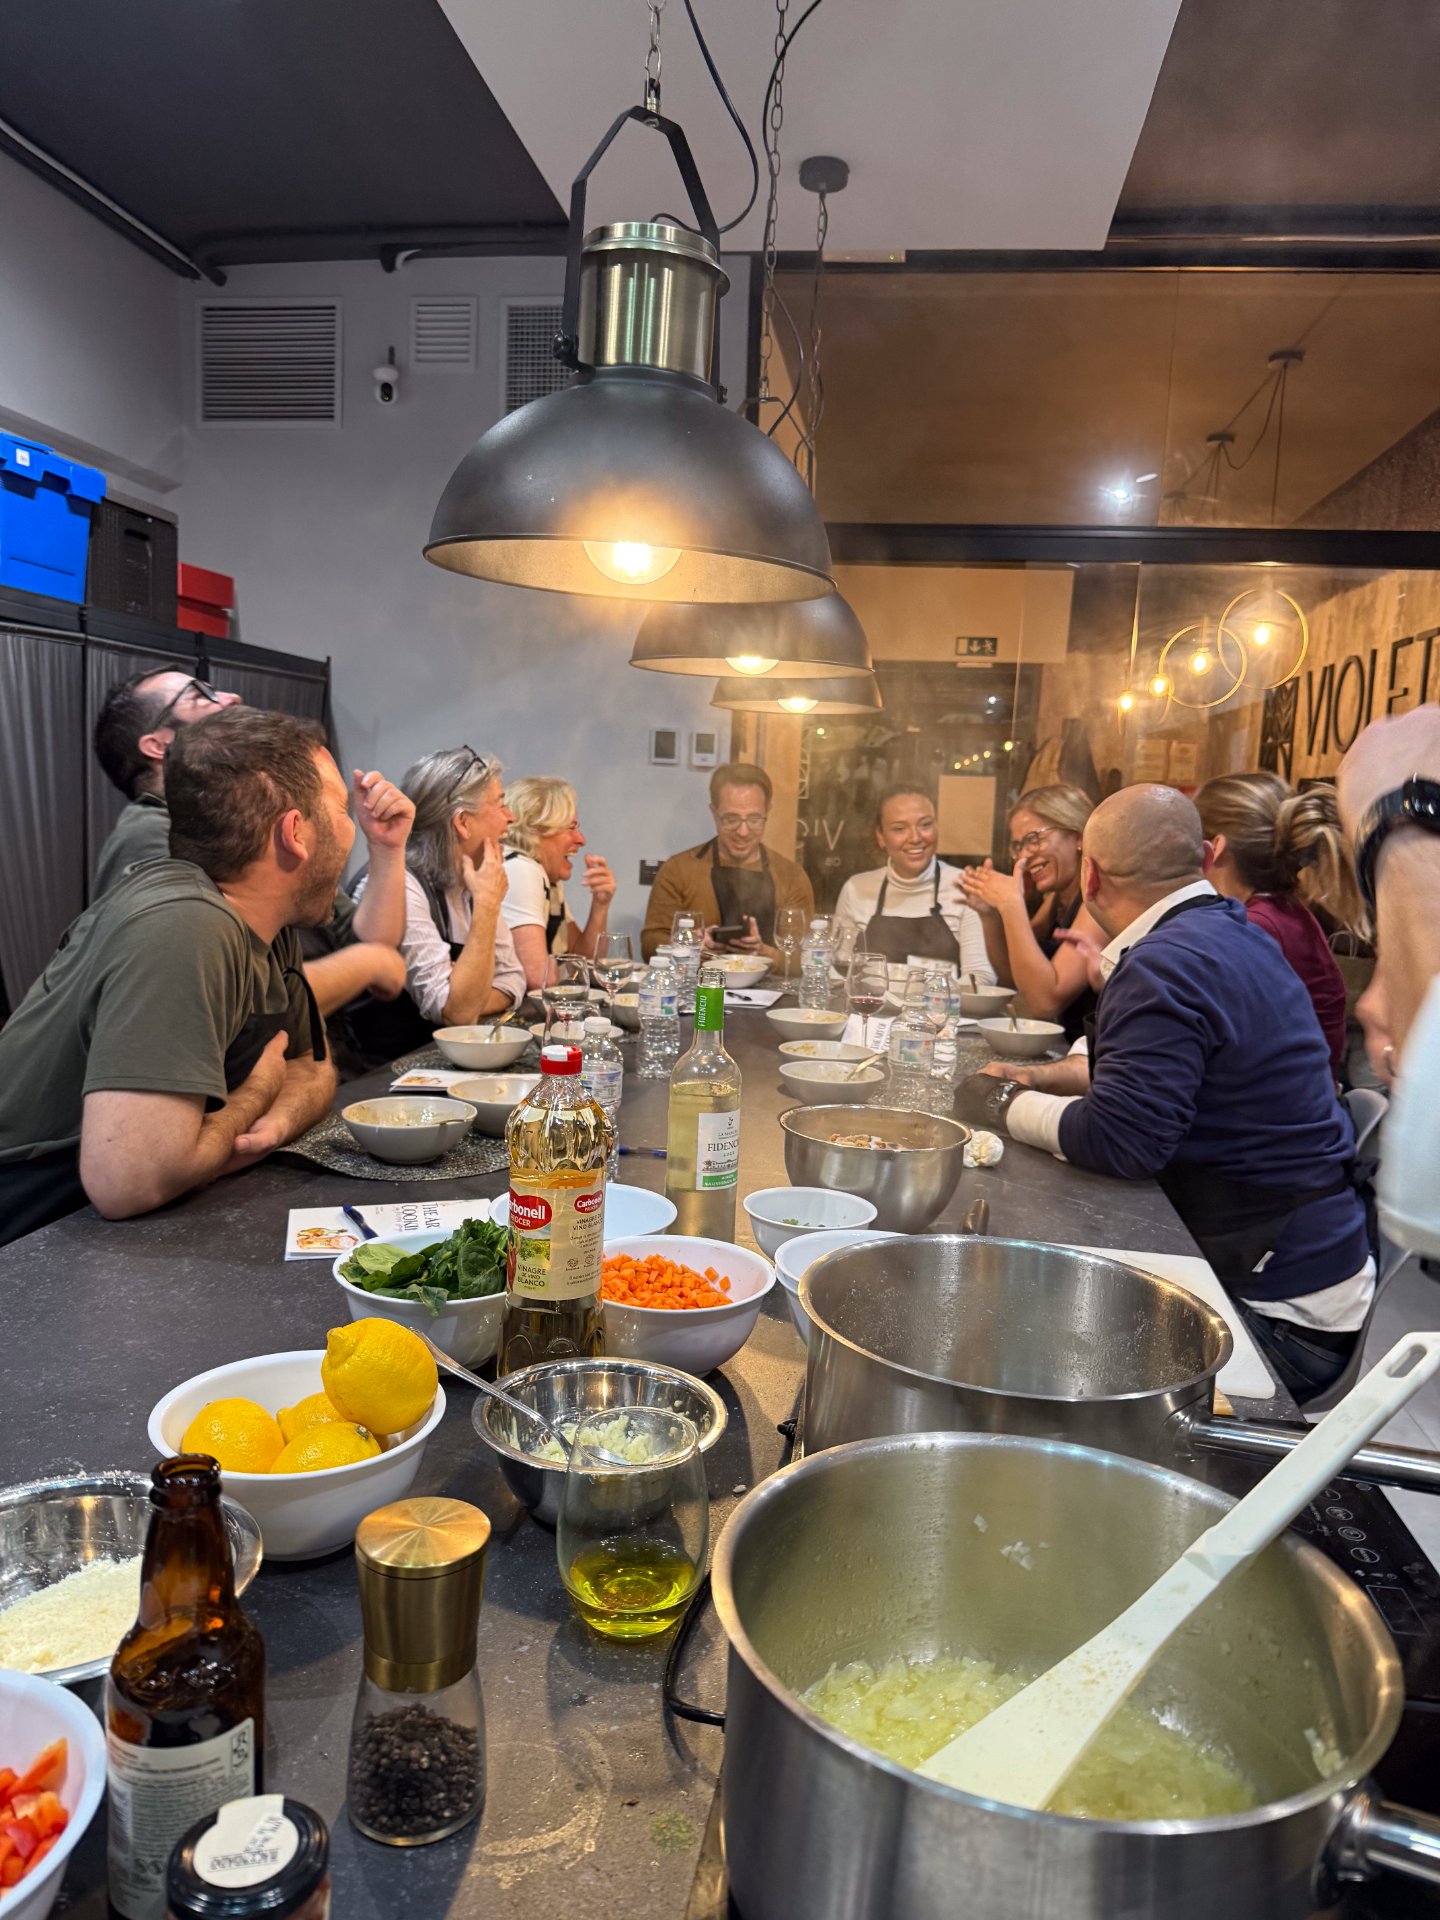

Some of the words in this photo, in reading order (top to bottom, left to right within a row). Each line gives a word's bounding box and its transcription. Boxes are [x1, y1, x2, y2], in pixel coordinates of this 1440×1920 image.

[697, 995, 708, 1027] FIDENCIO
[422, 1202, 438, 1216] THE
[573, 1223, 587, 1231] VINO
[517, 1264, 547, 1276] VINAGRE
[517, 1276, 545, 1287] BLANCO
